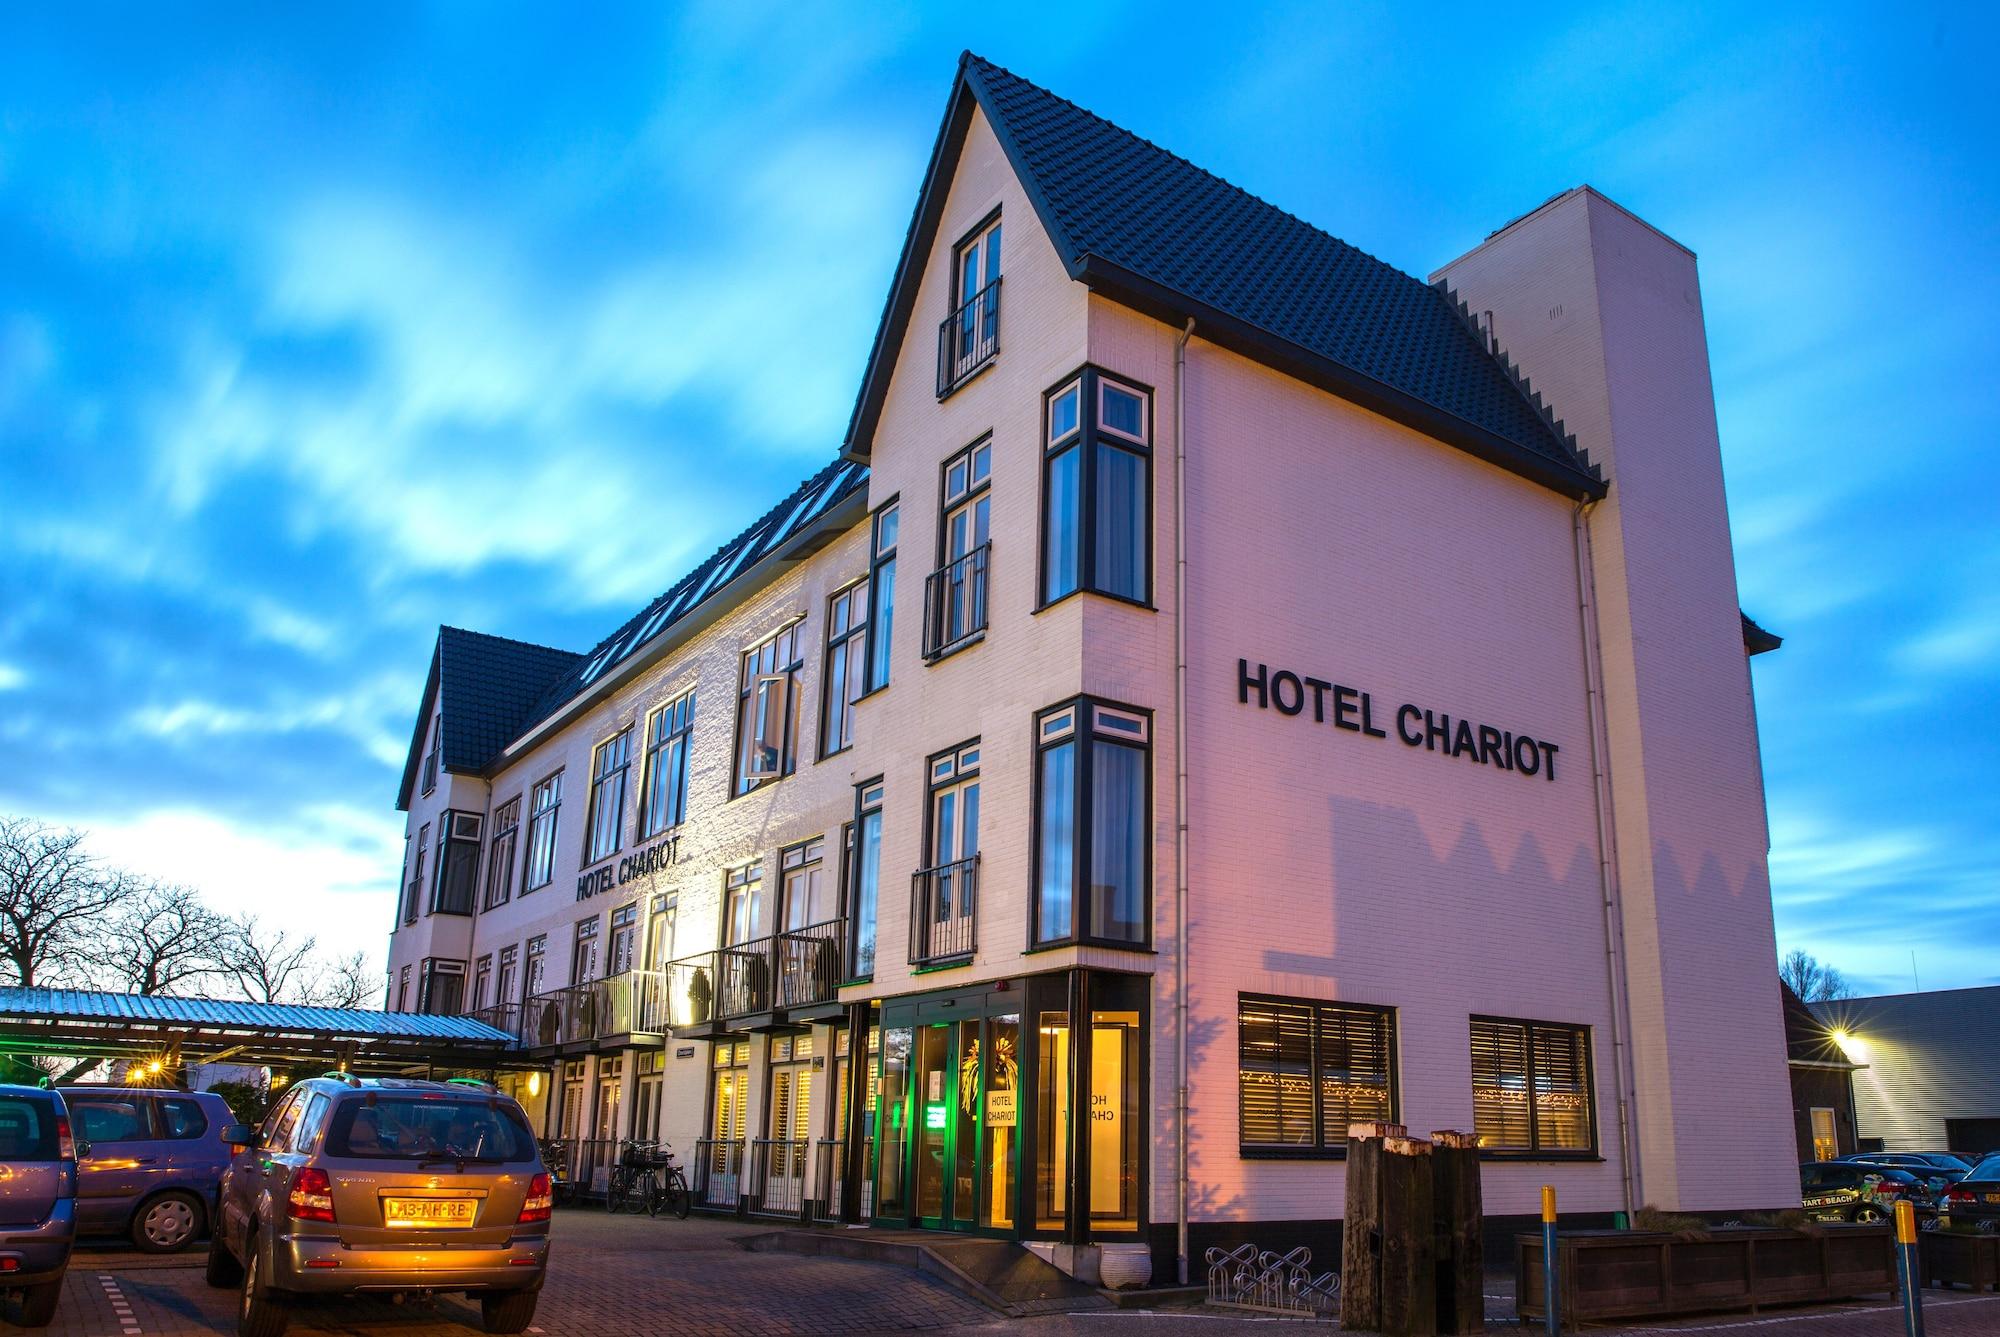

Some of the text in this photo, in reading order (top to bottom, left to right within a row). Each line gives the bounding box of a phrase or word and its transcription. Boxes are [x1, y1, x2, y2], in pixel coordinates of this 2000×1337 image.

[1238, 658, 1559, 781] HOTEL CHARIOT
[576, 835, 681, 902] HOTEL CHARIOT
[987, 1110, 1016, 1121] CHARIOT
[991, 1096, 1012, 1107] HOTEL
